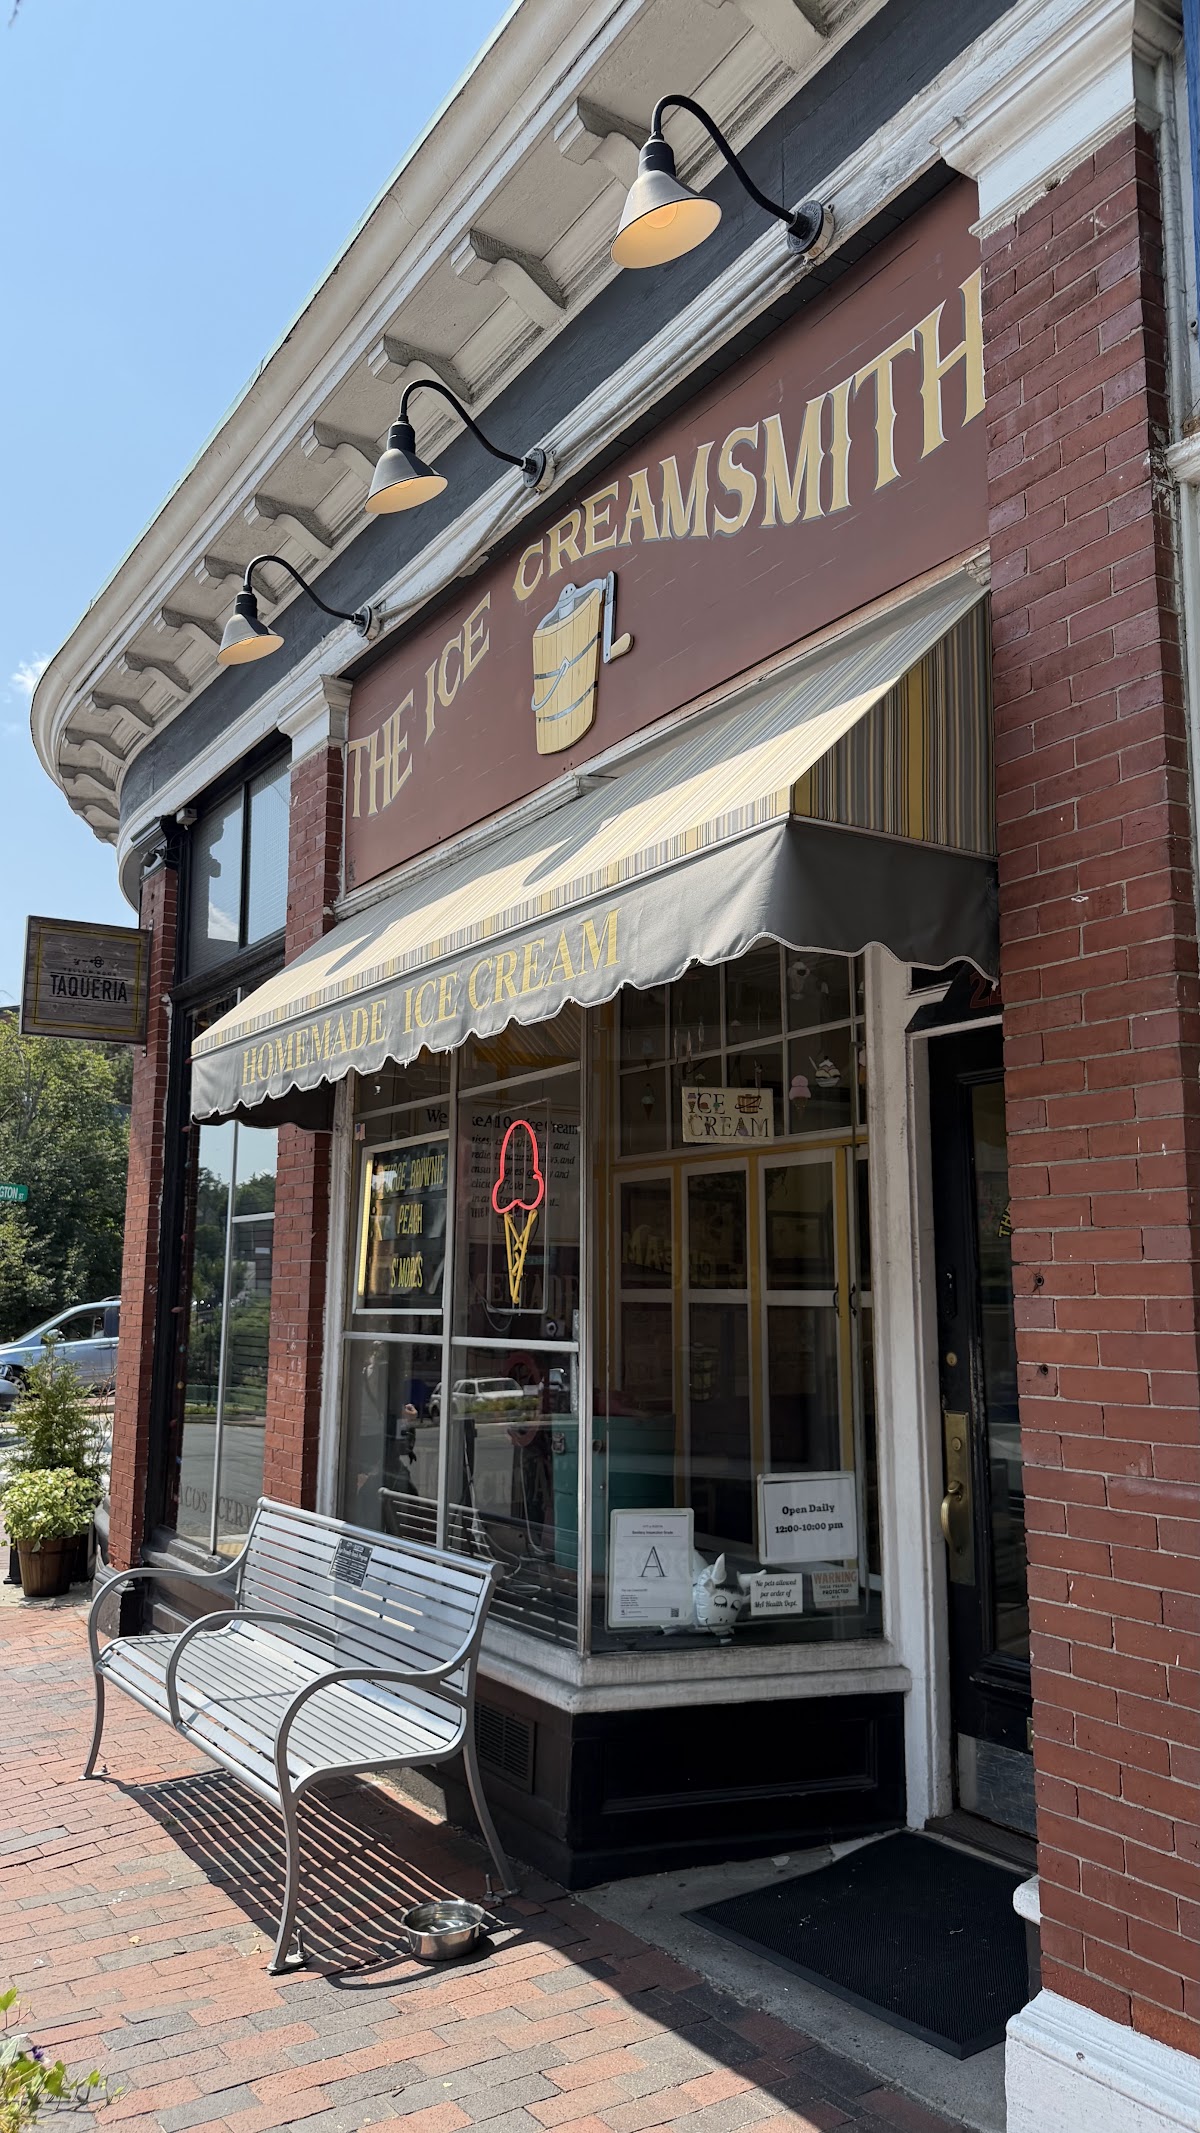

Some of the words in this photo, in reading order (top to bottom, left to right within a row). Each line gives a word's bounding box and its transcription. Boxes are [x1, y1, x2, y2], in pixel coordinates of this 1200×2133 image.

[348, 690, 415, 819] THE
[424, 593, 490, 744] ICE
[512, 267, 987, 601] CREAMSMITH
[50, 974, 128, 1002] TAQUERIA
[241, 998, 387, 1087] HOMEMADE
[402, 971, 458, 1034] ICE
[468, 907, 622, 1011] CREAM
[687, 1092, 725, 1115] ICE
[425, 1108, 448, 1123] We
[687, 1113, 769, 1138] CREAM
[553, 1141, 570, 1151] and
[560, 1155, 575, 1165] and
[554, 1169, 570, 1179] and
[397, 1203, 423, 1235] PEACH
[782, 1506, 807, 1516] Open
[808, 1503, 834, 1513] Daily
[775, 1522, 826, 1534] 12:00-10:00
[827, 1522, 843, 1532] pm
[637, 1546, 668, 1577] A
[764, 1580, 775, 1588] pets
[776, 1578, 796, 1586] allowed
[813, 1570, 857, 1584] WARNING
[786, 1589, 792, 1598] of
[784, 1600, 798, 1608] Dept.
